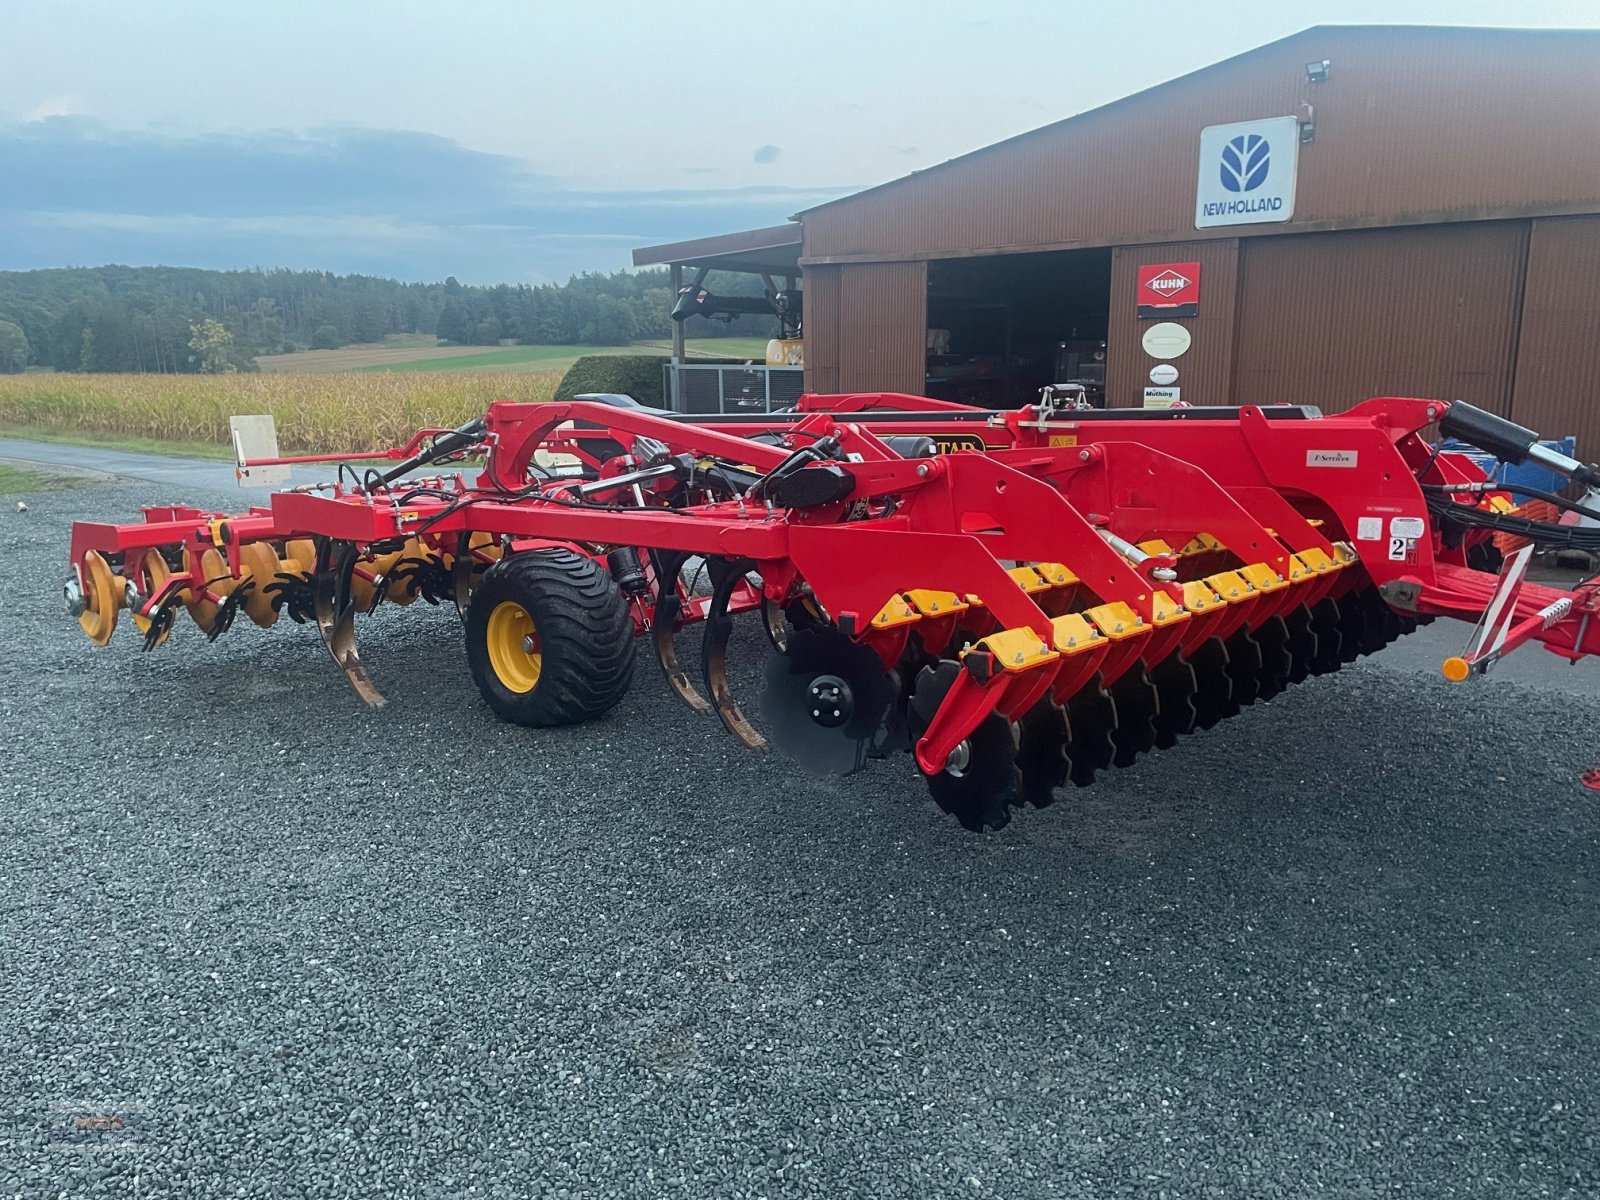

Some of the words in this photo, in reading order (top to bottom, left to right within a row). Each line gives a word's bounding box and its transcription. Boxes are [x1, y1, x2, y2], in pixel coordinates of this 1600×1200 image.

[1203, 202, 1227, 217] NEW
[1227, 197, 1283, 215] HOLLAND
[1152, 278, 1185, 289] KUHN
[1391, 538, 1404, 556] 2
